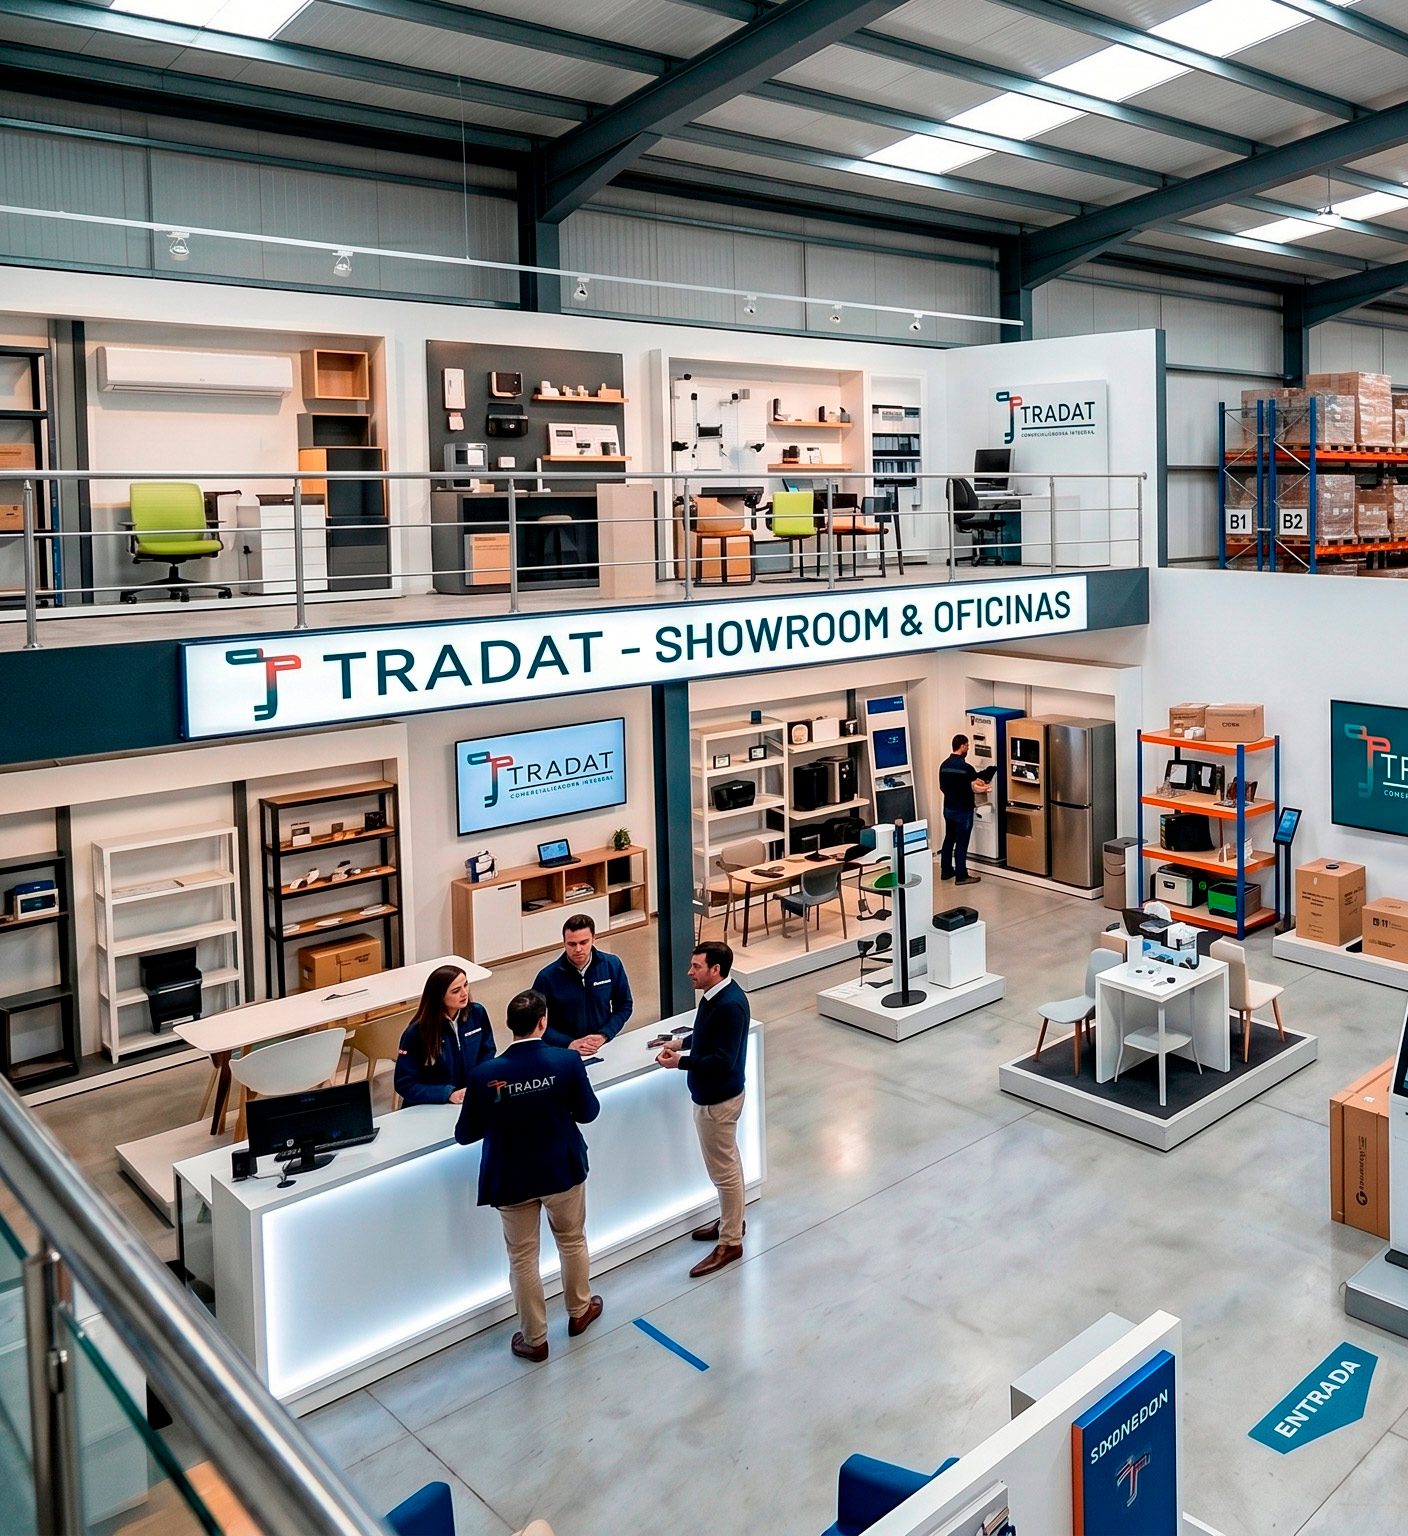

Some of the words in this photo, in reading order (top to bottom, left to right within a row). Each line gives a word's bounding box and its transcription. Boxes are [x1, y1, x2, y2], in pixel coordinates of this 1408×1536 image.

[1020, 401, 1095, 424] TRADAT
[1230, 513, 1246, 530] B1
[1283, 513, 1303, 529] B2
[322, 630, 603, 700] TRADAT
[621, 647, 641, 655] -
[655, 606, 889, 664] SHOWROOM
[900, 603, 923, 637] &
[934, 590, 1071, 633] OFICINAS
[506, 751, 614, 785] TRADAT
[507, 1075, 556, 1095] TRADAT
[1273, 1360, 1362, 1439] ENTRADA
